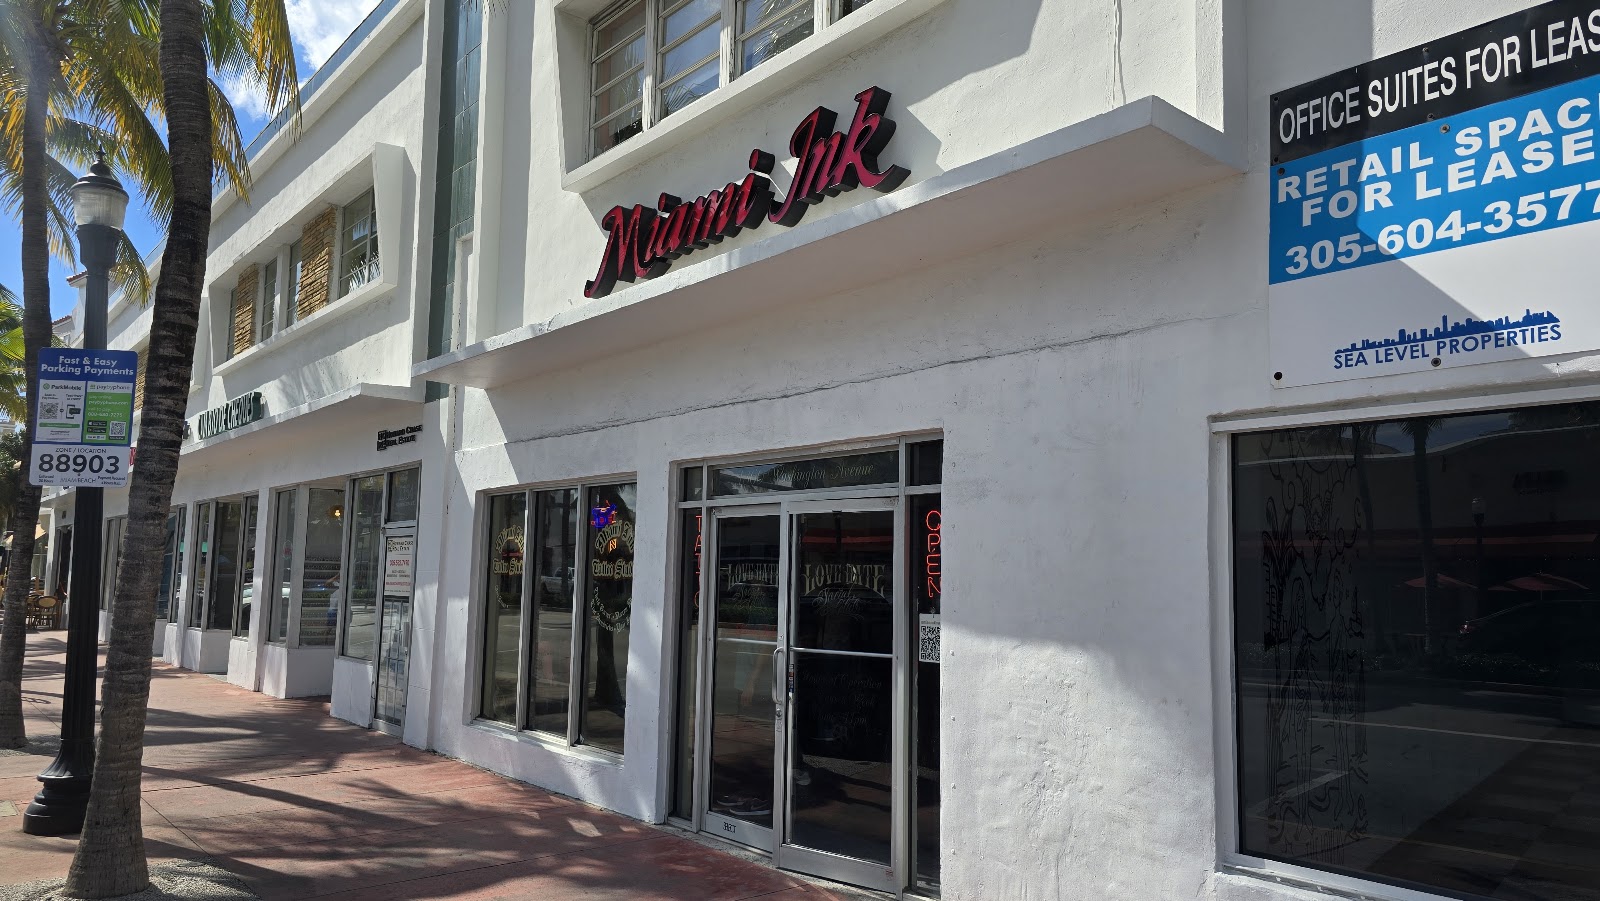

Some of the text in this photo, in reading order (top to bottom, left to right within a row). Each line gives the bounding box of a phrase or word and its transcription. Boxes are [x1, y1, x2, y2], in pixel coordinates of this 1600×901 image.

[1279, 86, 1361, 144] OFFICE
[1367, 56, 1457, 119] SUITES
[1465, 35, 1522, 90] FOR
[1277, 94, 1600, 204] RETAIL SPAC
[584, 86, 908, 298] Miami Ink
[1302, 129, 1594, 228] FOR LEASE
[1285, 182, 1600, 275] 305-604-3577
[59, 356, 117, 368] Fast & Easy
[1333, 324, 1562, 370] SEA LEVEL PROPERTIES
[41, 363, 134, 376] Parking Payments
[96, 383, 130, 391] paybyphone
[38, 453, 120, 474] 88903
[773, 464, 826, 488] Washington
[830, 463, 875, 480] Avenue
[925, 509, 942, 598] OPEN
[727, 563, 755, 592] LOVE
[800, 563, 887, 599] LOVE HATE
